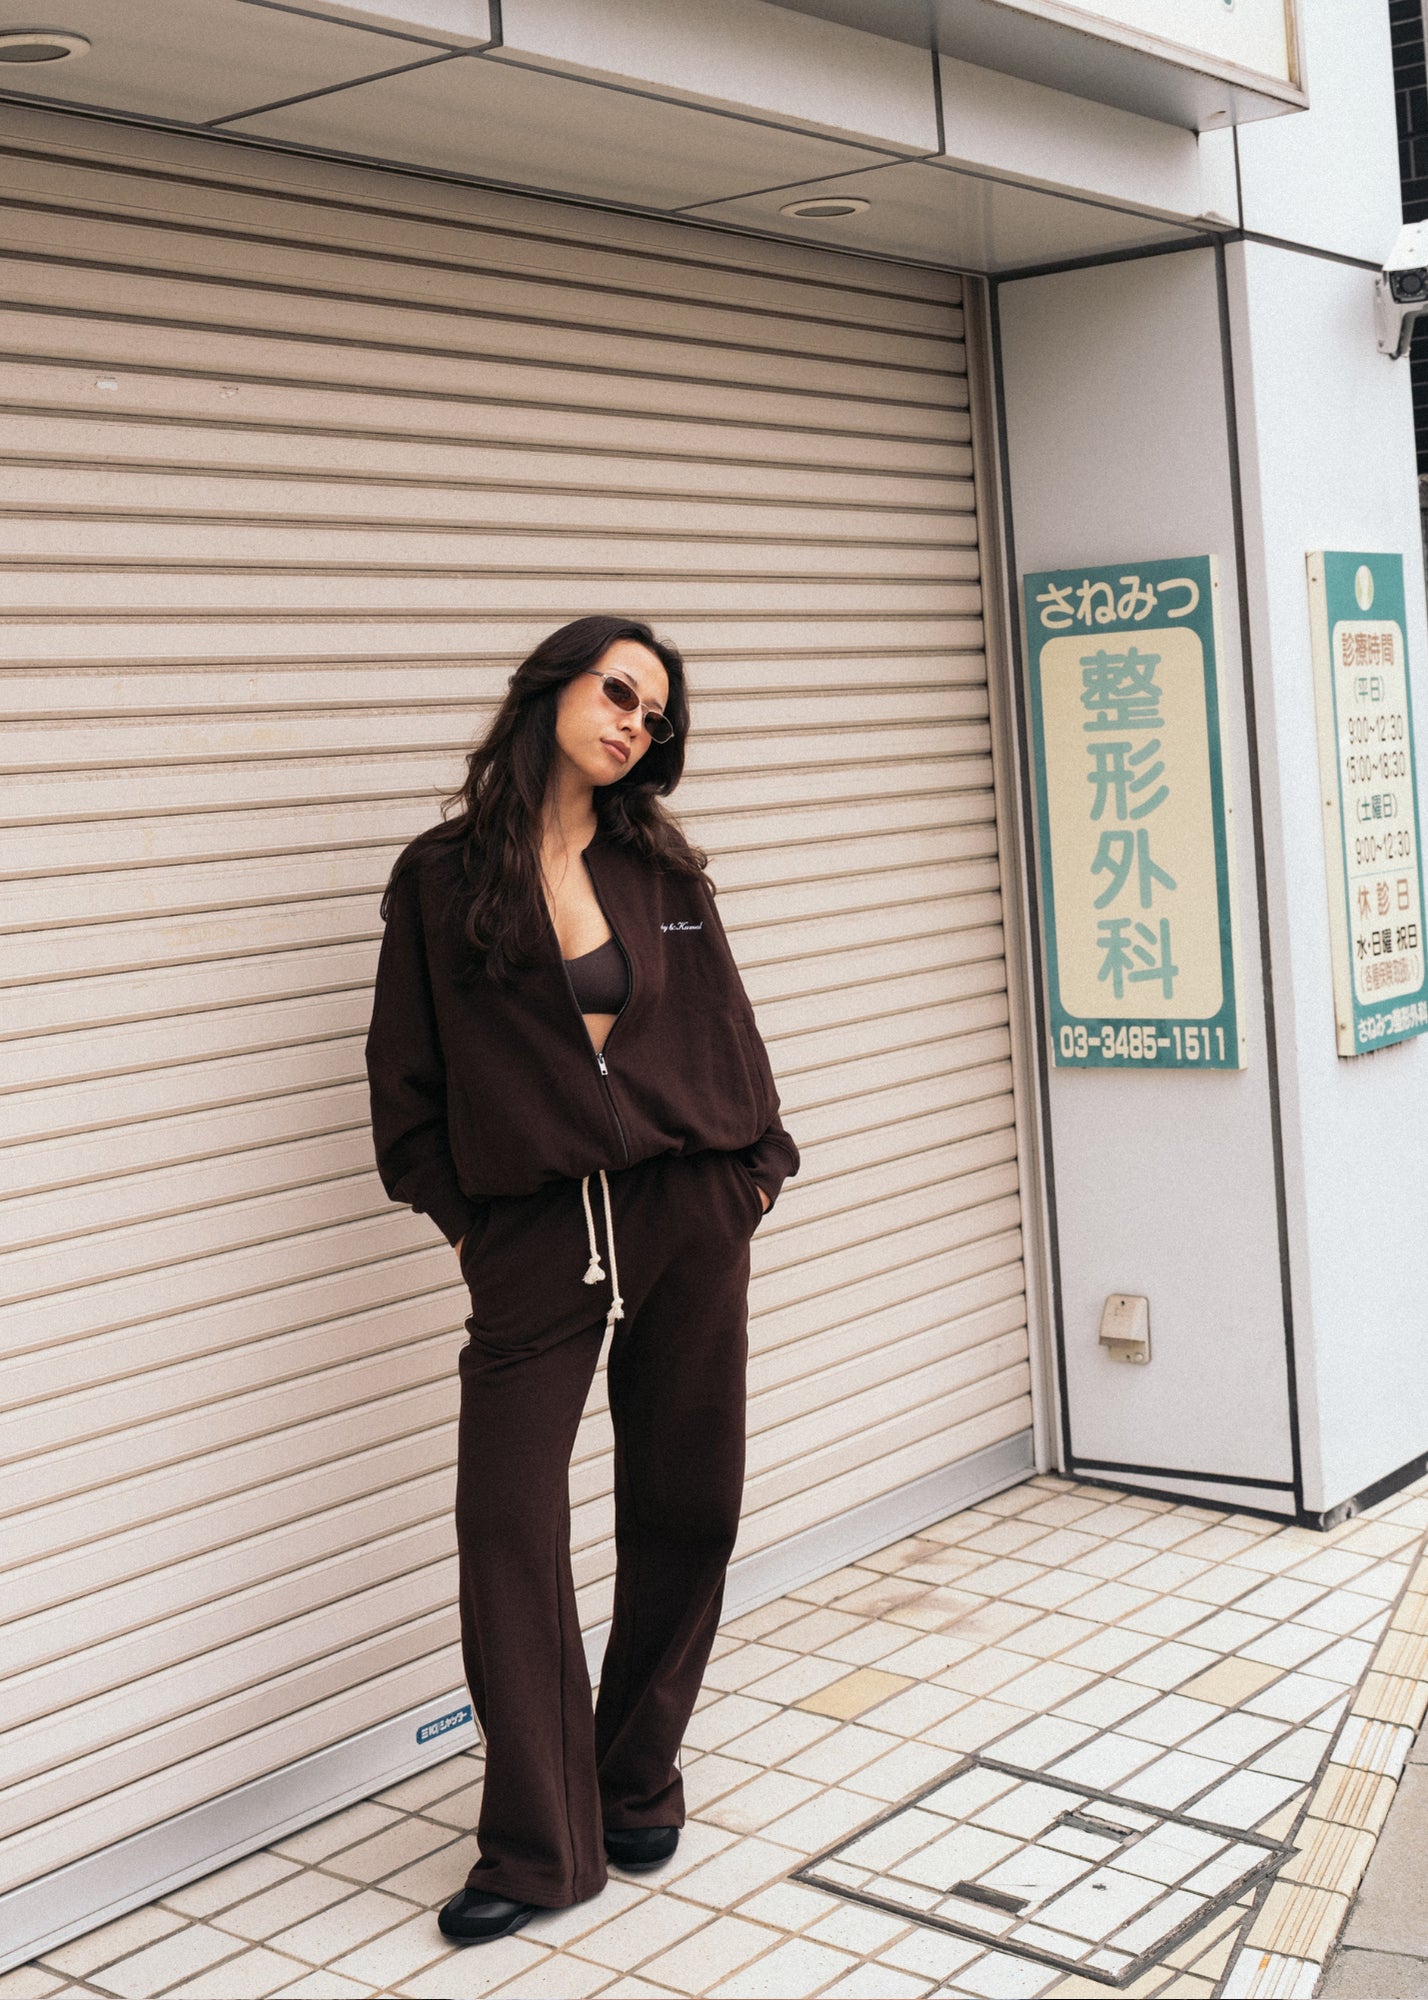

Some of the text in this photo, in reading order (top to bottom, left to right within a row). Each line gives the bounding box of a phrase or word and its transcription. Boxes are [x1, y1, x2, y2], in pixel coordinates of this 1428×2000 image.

[1036, 574, 1201, 630] さねみつ
[1341, 632, 1395, 667] 診療時間
[1079, 645, 1179, 1001] 整形外科
[1060, 1024, 1226, 1060] 03-3485-1511
